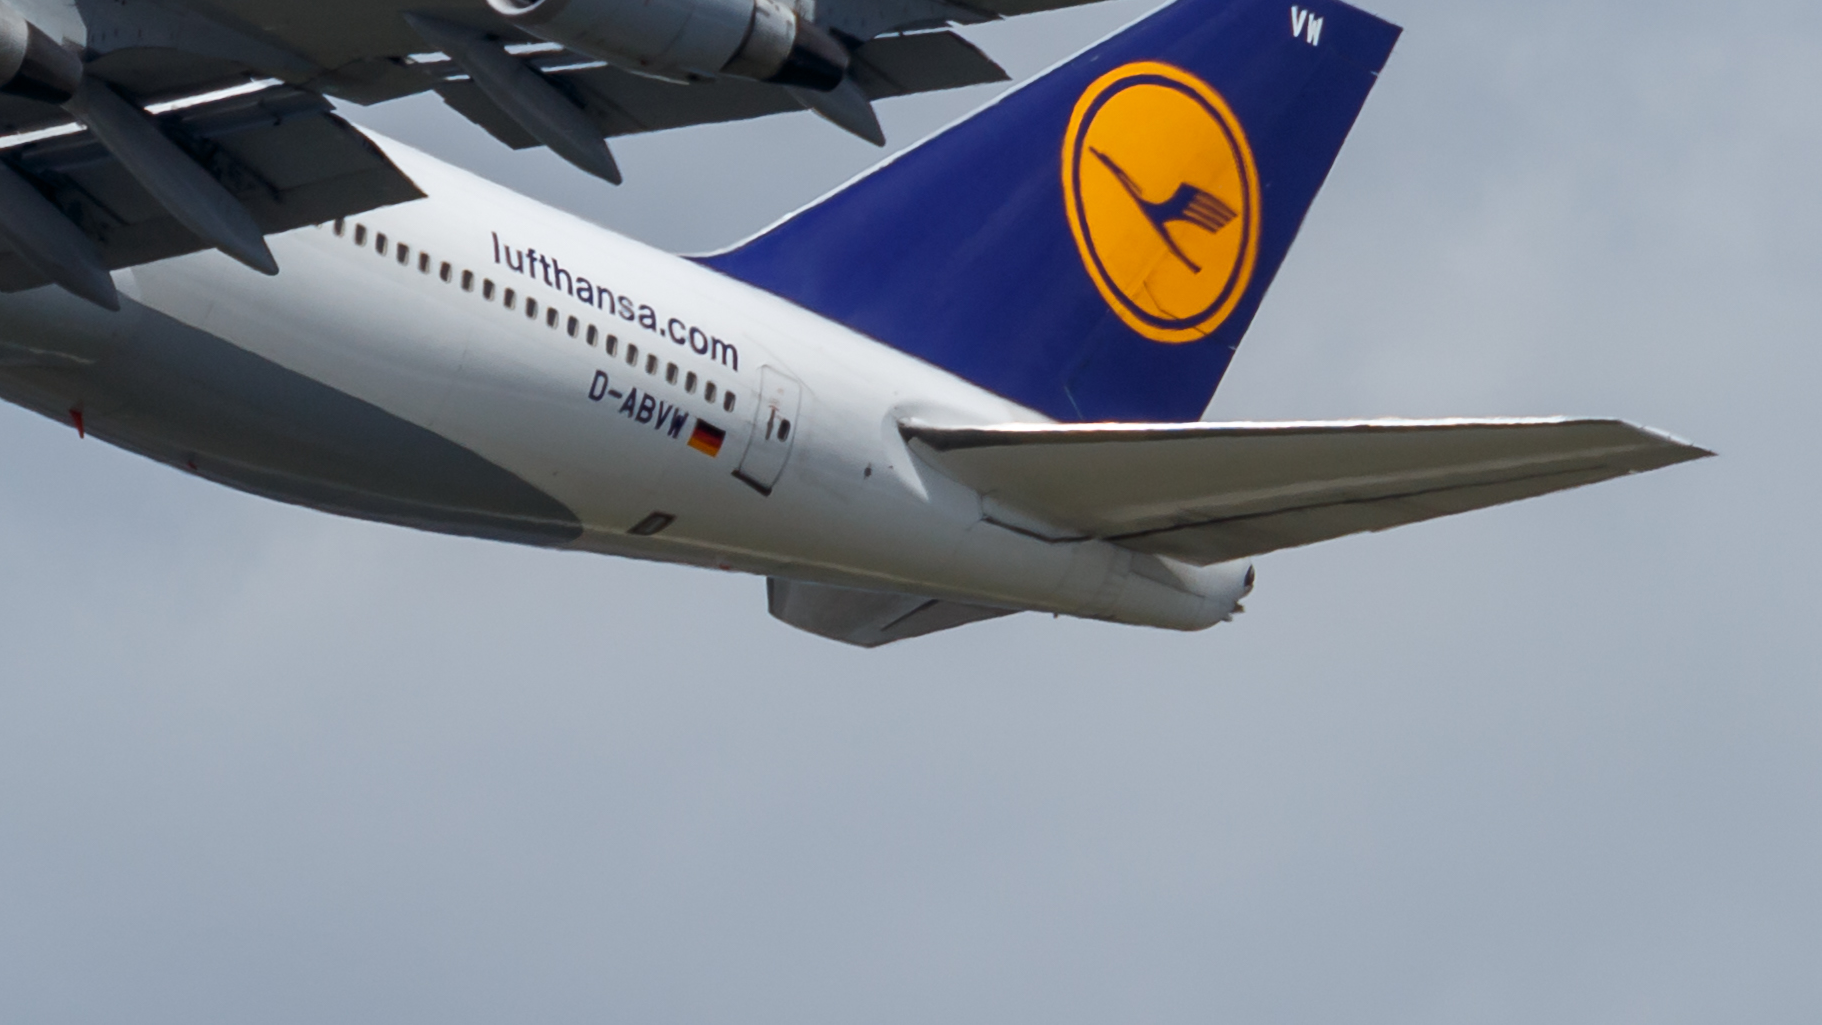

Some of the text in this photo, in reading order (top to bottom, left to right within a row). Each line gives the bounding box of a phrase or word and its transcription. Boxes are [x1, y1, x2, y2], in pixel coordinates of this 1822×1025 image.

[1291, 5, 1324, 47] VW
[491, 232, 739, 371] lufthansa.com
[588, 370, 689, 439] D-ABVW
